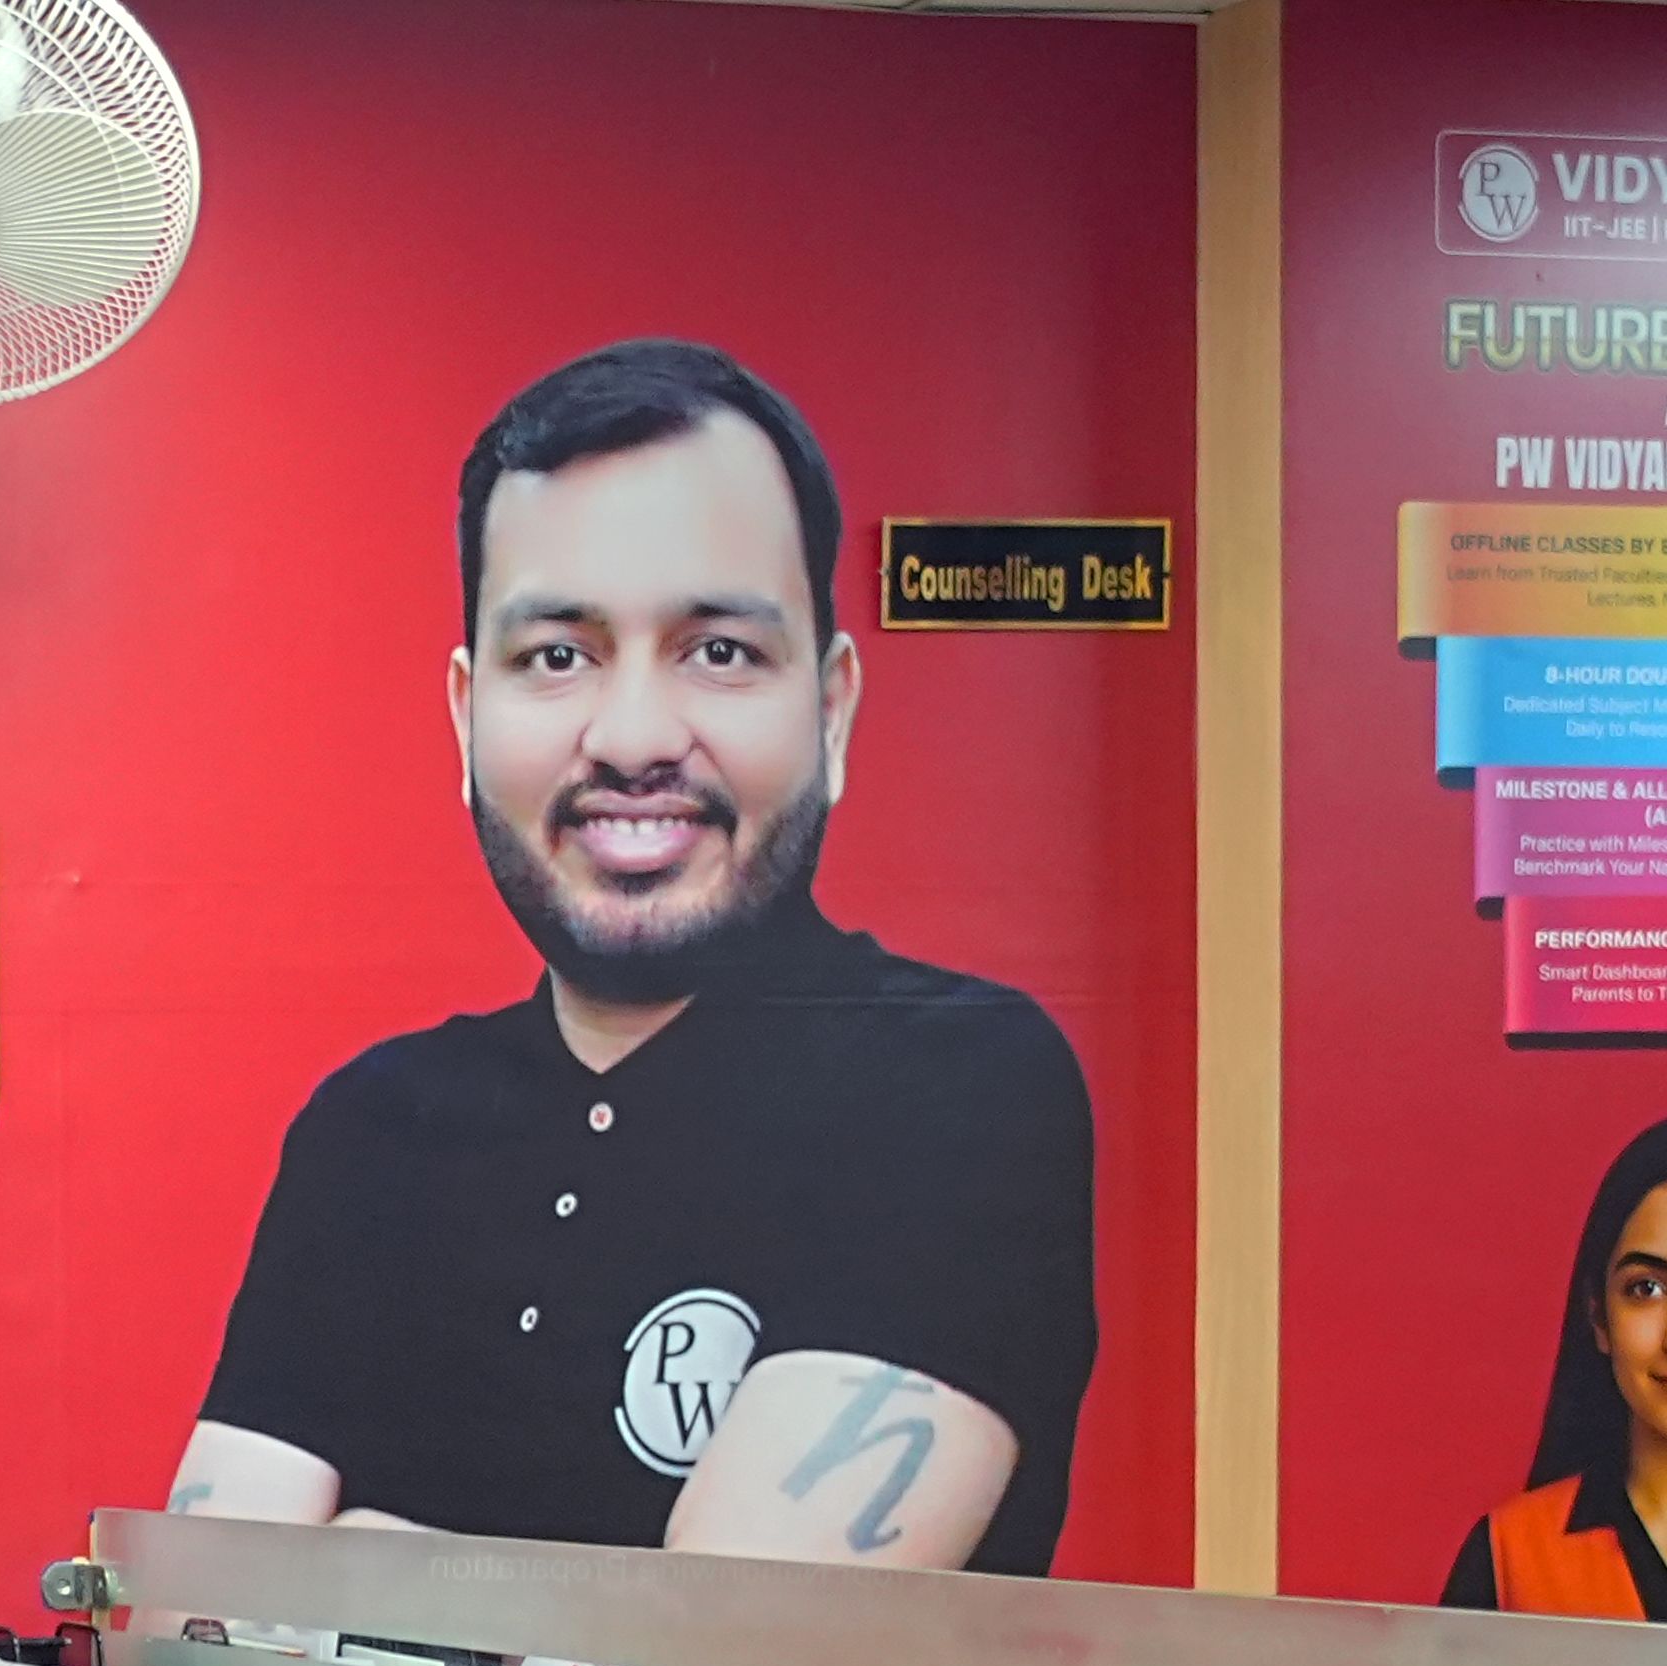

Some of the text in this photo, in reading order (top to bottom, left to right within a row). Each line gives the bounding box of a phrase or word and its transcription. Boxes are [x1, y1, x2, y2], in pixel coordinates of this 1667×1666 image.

[1564, 215, 1646, 239] IIT-JEE
[1496, 436, 1554, 490] PW
[1451, 534, 1654, 554] OFFLINE CLASSES BY
[898, 552, 1155, 613] Counselling Desk
[1545, 666, 1622, 685] 8-HOUR
[1496, 781, 1607, 800] MILESTONE
[1612, 781, 1627, 800] &
[1520, 835, 1622, 852] Practice with
[1514, 858, 1604, 876] Benchmark
[1609, 859, 1644, 876] Your
[1539, 964, 1588, 981] Smart
[1572, 986, 1654, 1003] Parents to
